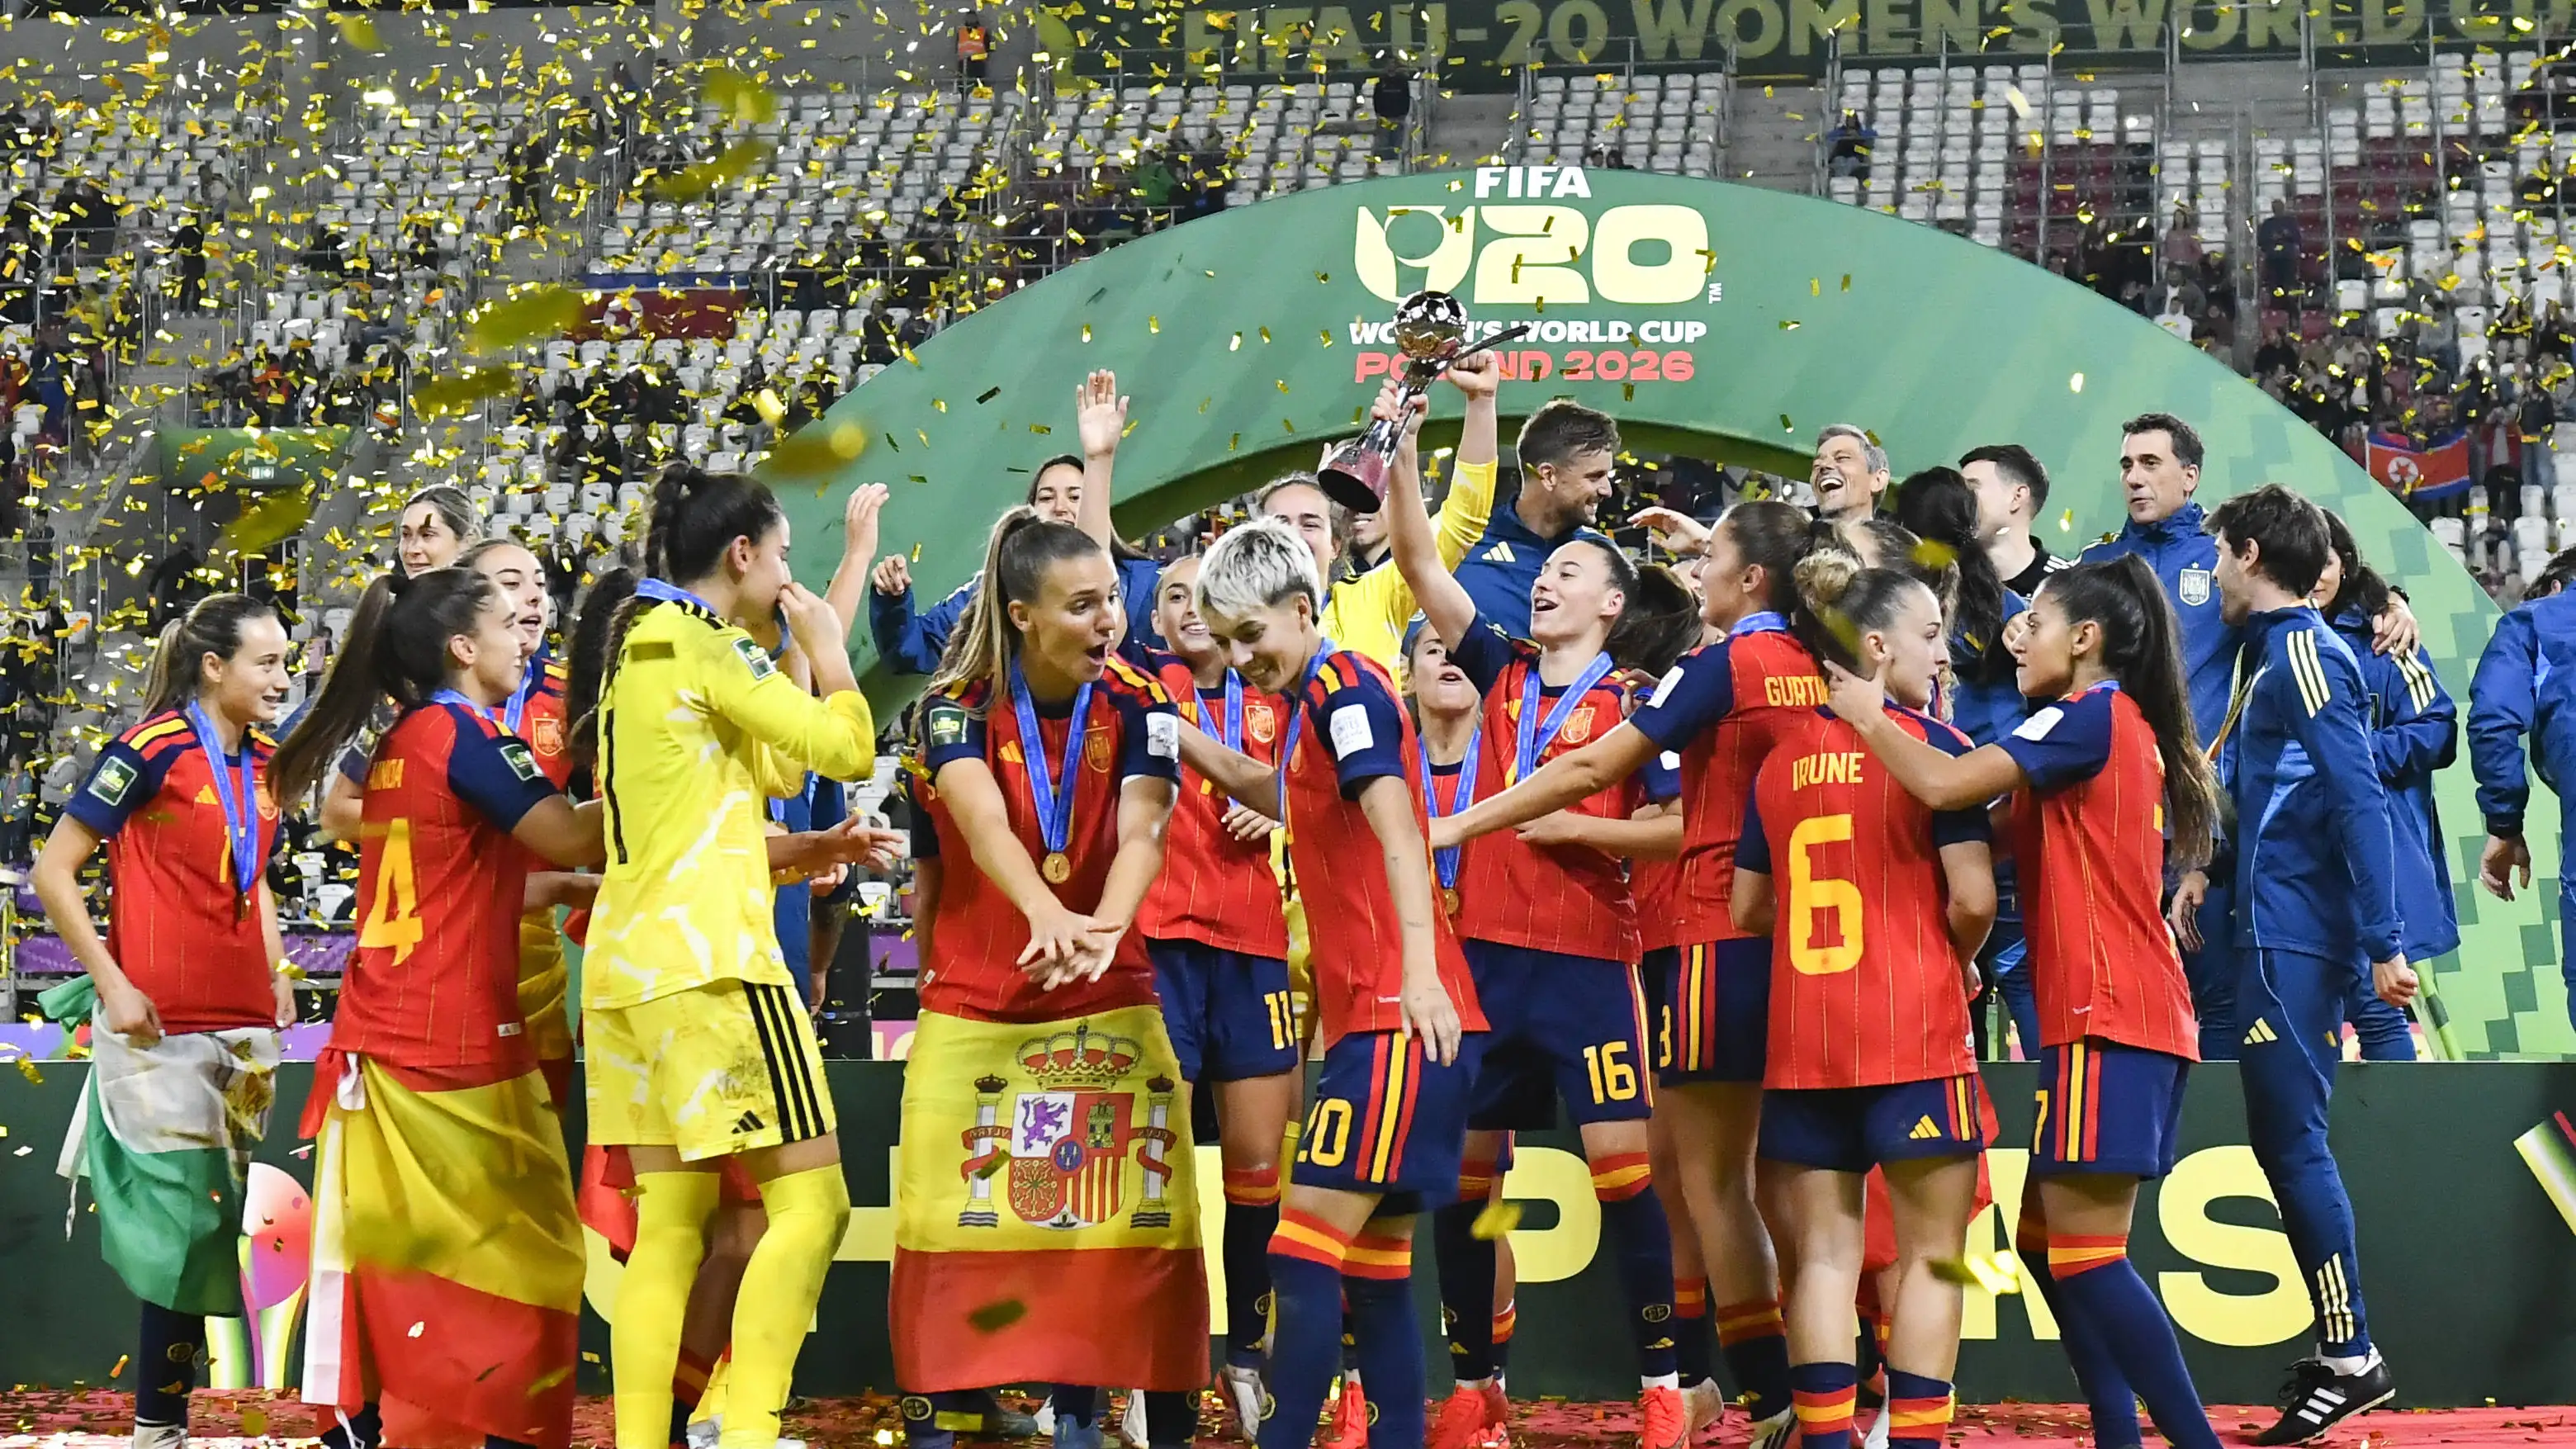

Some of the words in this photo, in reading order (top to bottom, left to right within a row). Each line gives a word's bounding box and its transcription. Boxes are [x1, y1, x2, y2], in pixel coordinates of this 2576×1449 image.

[1185, 4, 1371, 74] FIFA
[1390, 0, 1608, 66] U-20
[1631, 0, 2062, 60] WOMEN'S
[2087, 0, 2426, 50] WORLD
[2449, 0, 2573, 40] CU
[1475, 166, 1591, 198] FIFA
[1355, 205, 1709, 304] U20
[1510, 320, 1632, 343] WORLD
[1638, 320, 1707, 343] CUP
[1562, 350, 1695, 381] 2026
[1792, 753, 1865, 791] IRUNE
[358, 817, 424, 967] 4
[1788, 813, 1864, 976] 6
[1263, 991, 1295, 1050] 11
[1583, 1040, 1636, 1105] 16
